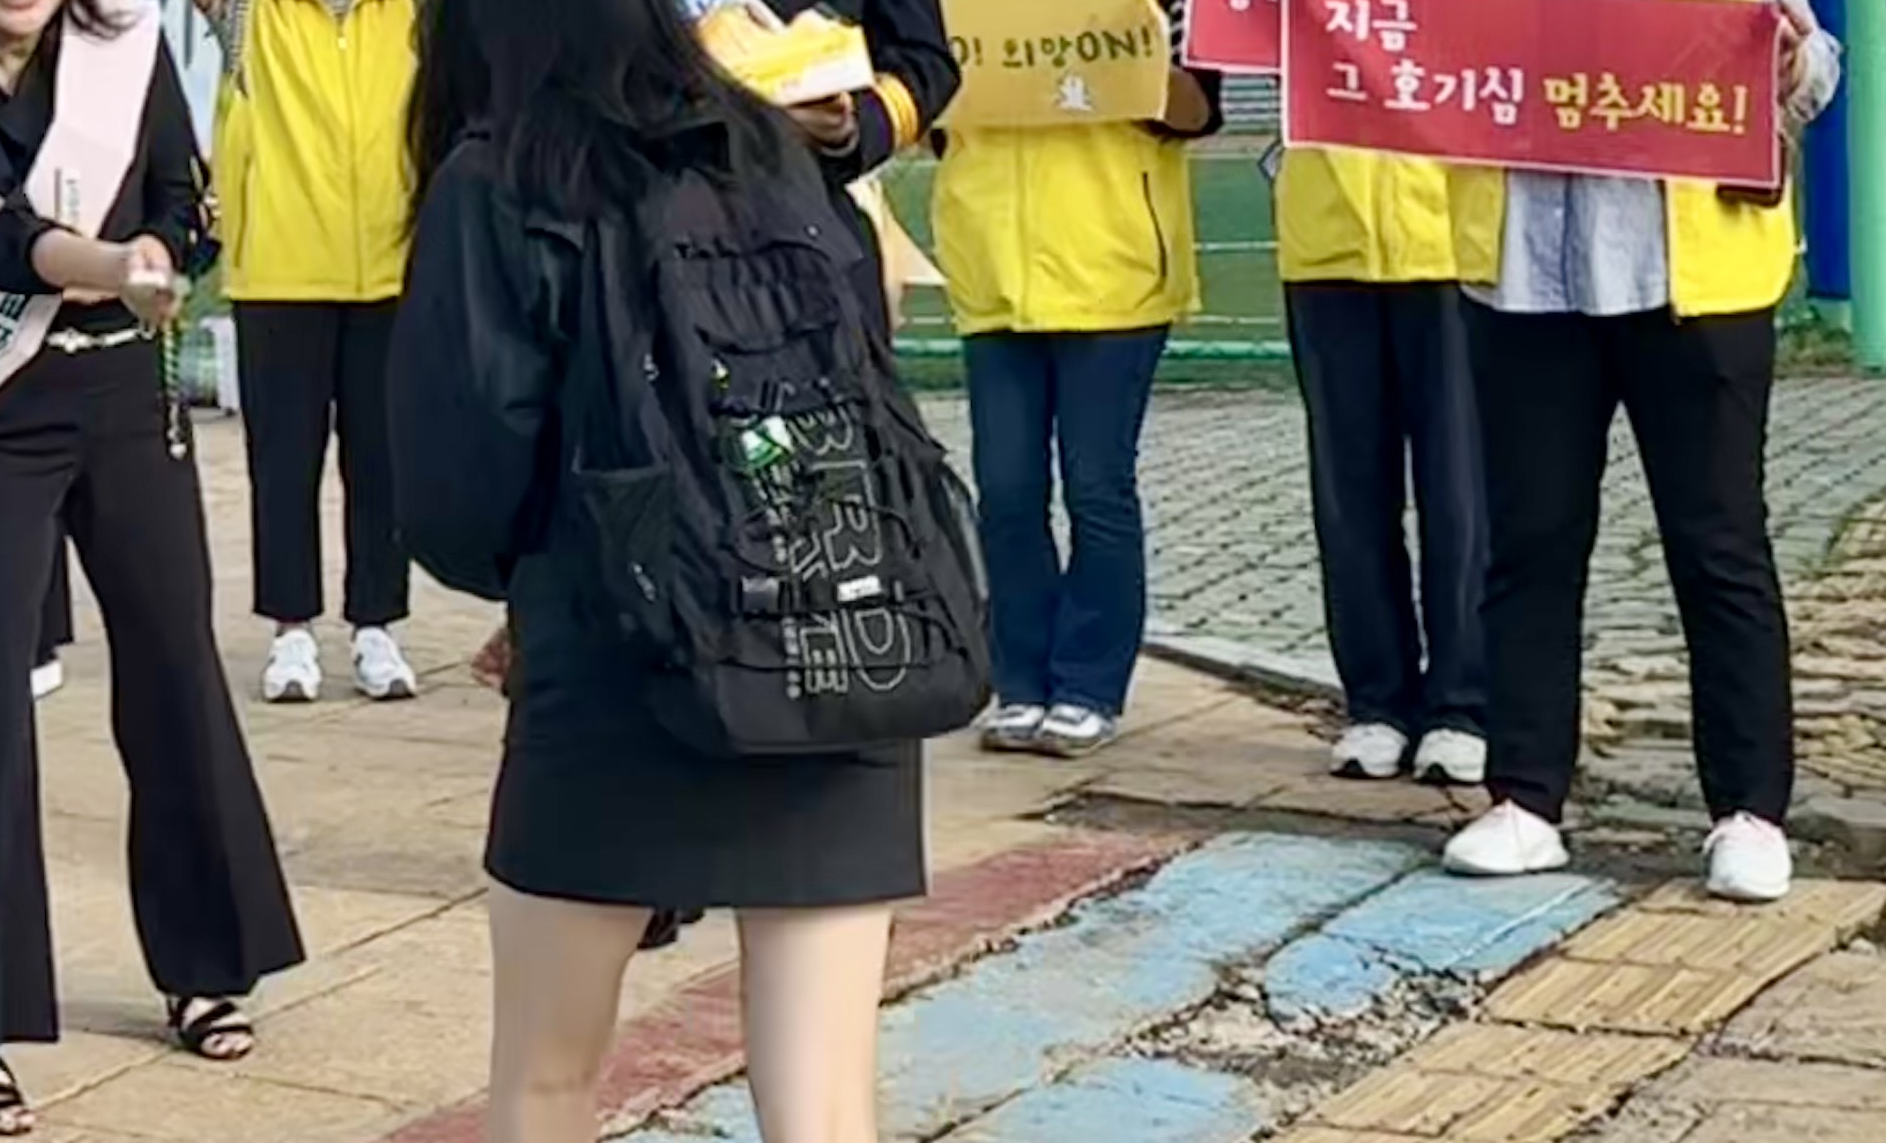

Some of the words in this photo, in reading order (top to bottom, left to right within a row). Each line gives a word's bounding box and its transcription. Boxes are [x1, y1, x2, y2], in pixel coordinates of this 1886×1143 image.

[1002, 26, 1153, 67] 희망ON!
[1325, 61, 1368, 101] 그
[1383, 58, 1524, 125] 호기심
[1542, 71, 1748, 135] 멈추세요!
